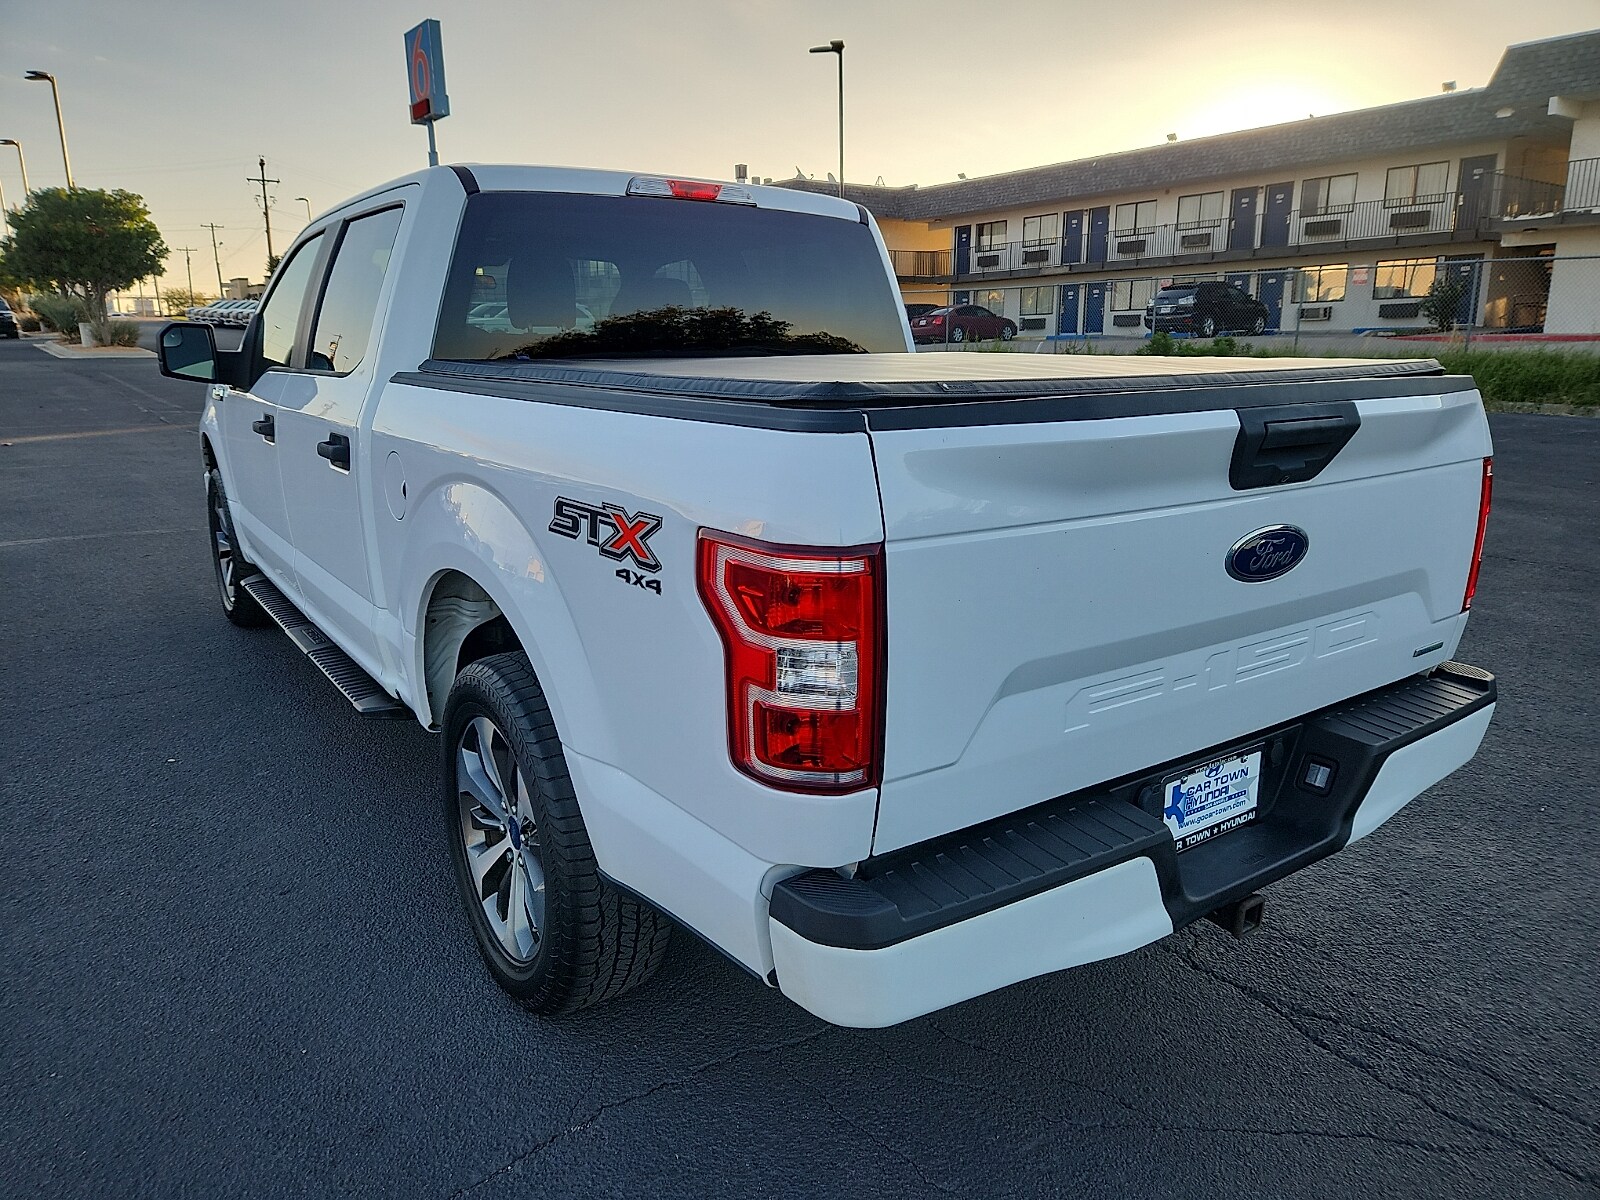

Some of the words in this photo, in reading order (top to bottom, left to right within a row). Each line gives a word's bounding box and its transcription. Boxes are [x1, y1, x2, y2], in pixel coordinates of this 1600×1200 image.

[412, 26, 430, 101] 6
[548, 495, 662, 574] STX
[1249, 538, 1295, 571] Ford
[1064, 611, 1380, 733] F-150
[1185, 785, 1229, 811] HYUNDAI
[1186, 780, 1211, 797] CAR
[1214, 767, 1249, 786] TOWN
[1186, 829, 1211, 846] TOWN
[1220, 811, 1256, 832] HYUNDAI
